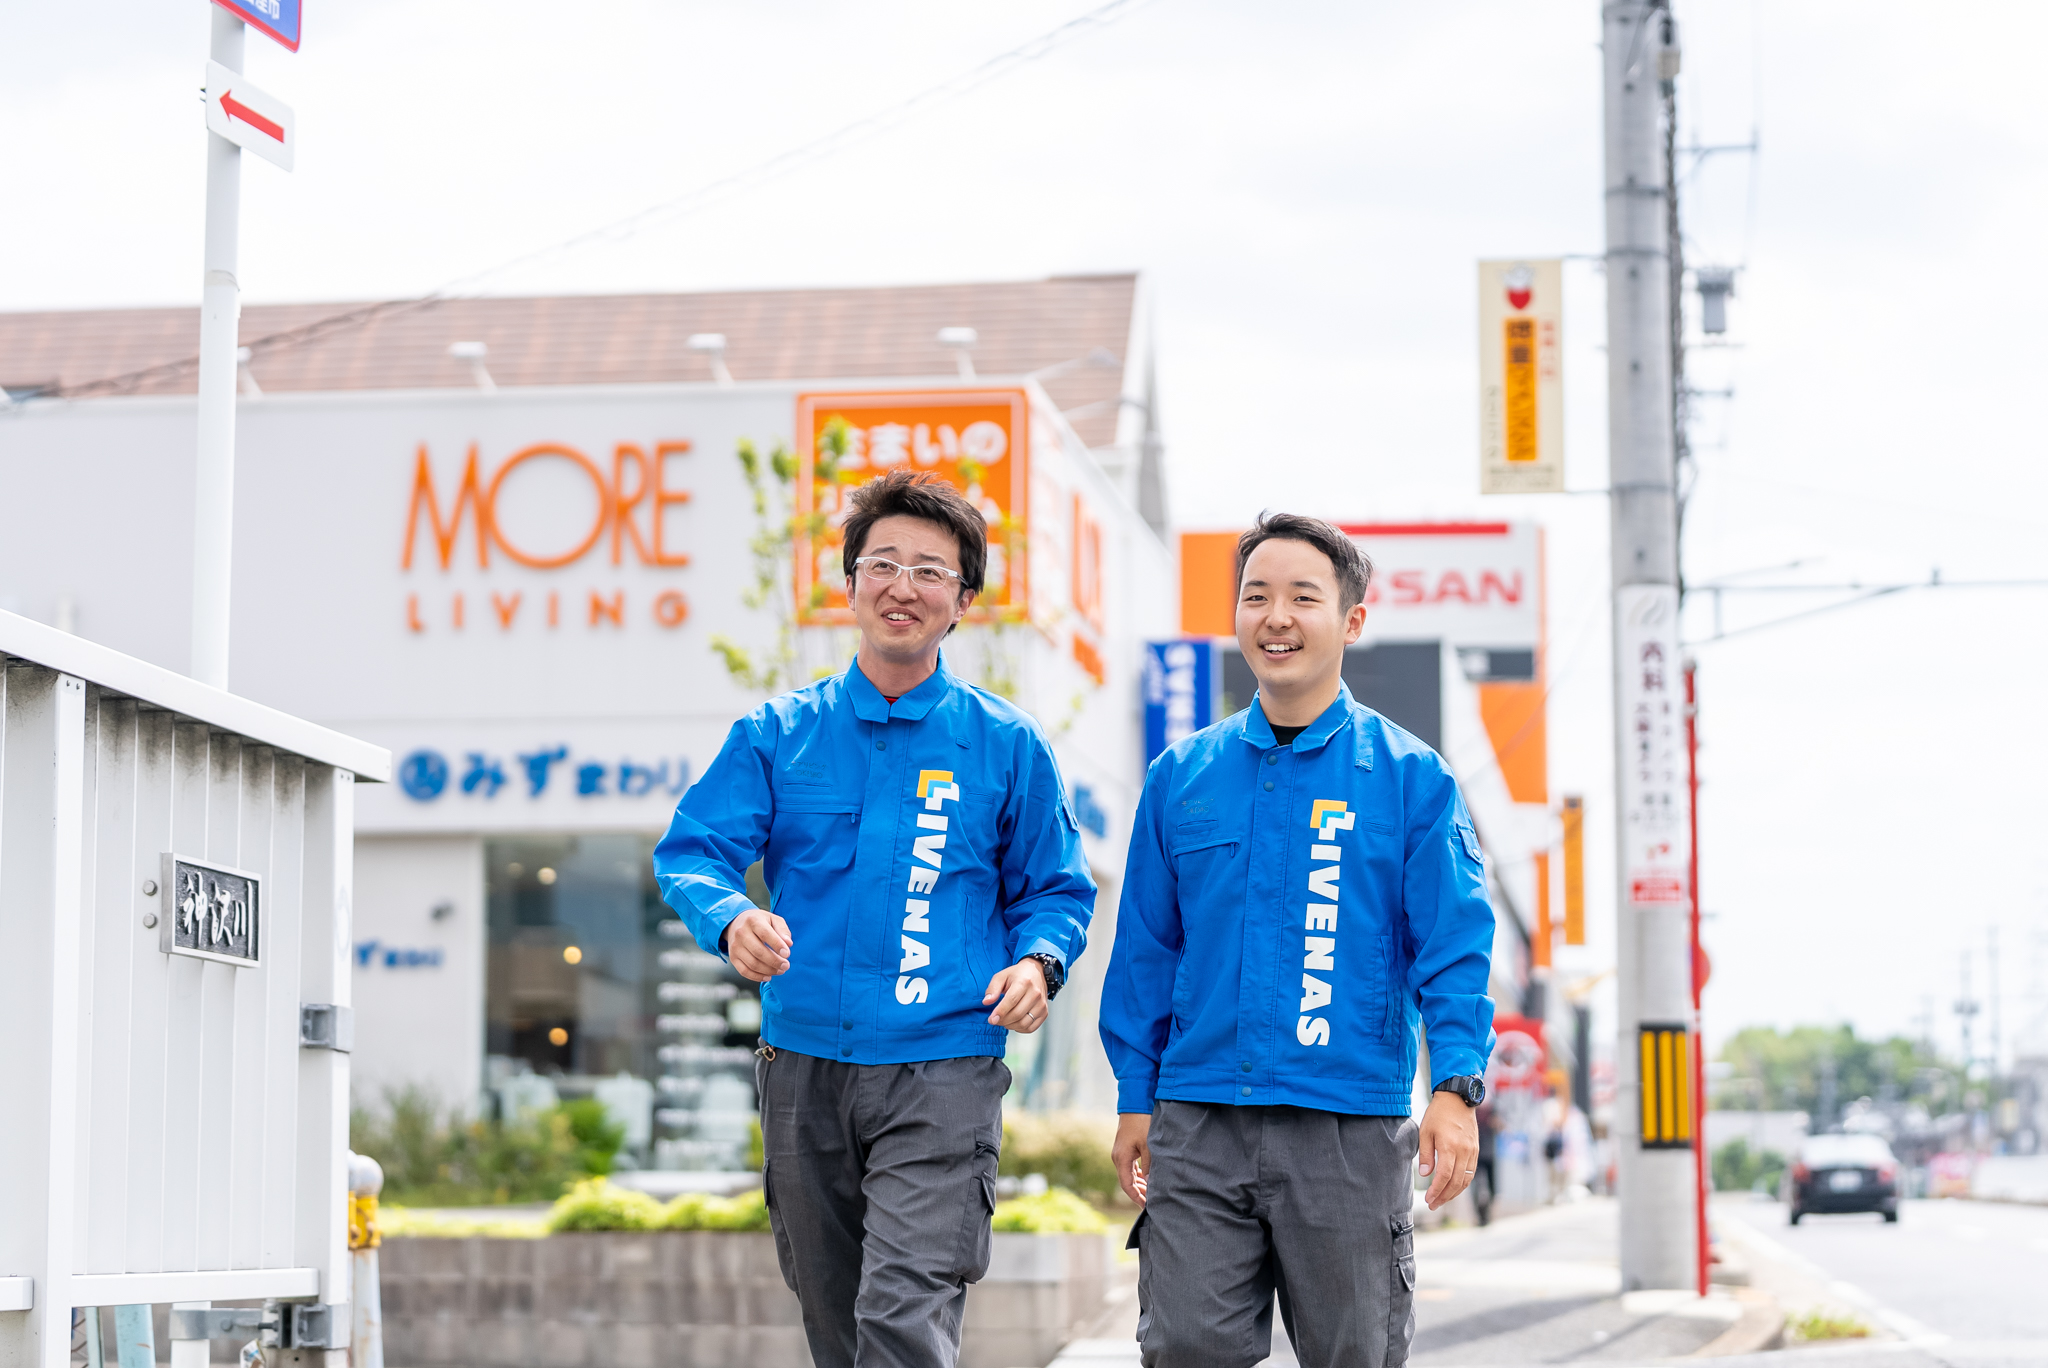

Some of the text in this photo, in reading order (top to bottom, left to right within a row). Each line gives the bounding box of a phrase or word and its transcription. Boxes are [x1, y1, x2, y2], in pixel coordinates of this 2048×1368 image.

[402, 440, 690, 571] MORE
[408, 590, 688, 632] LIVING
[180, 868, 254, 955] 神沢川
[895, 770, 960, 1005] LIVENAS
[1296, 799, 1356, 1046] LIVENAS
[353, 939, 445, 968] ずまわり
